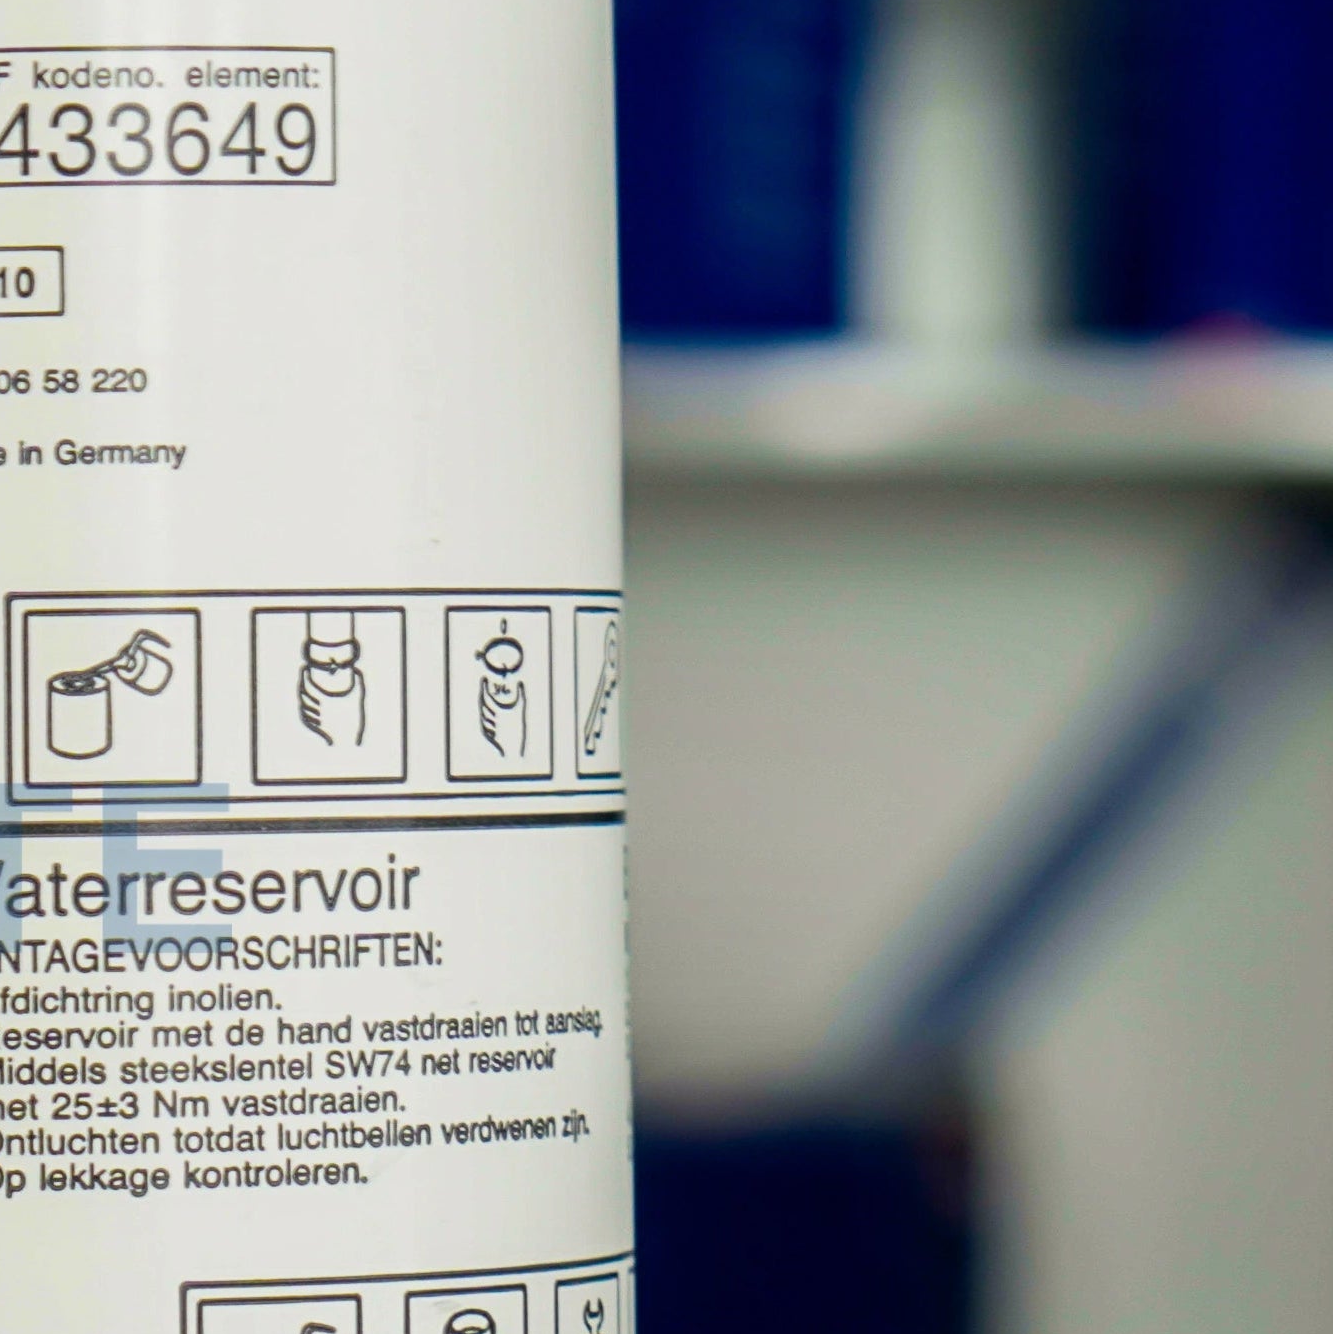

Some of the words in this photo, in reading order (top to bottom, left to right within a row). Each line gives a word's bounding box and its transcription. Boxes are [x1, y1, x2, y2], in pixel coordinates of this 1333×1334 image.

[33, 60, 164, 91] kodeno.
[185, 60, 321, 91] element:
[42, 369, 80, 394] 58
[92, 368, 148, 394] 220
[19, 440, 43, 466] in
[54, 439, 186, 470] Germany
[168, 983, 283, 1013] inolien.
[152, 1020, 214, 1049] met
[226, 1017, 265, 1047] de
[277, 1015, 352, 1046] hand
[363, 1009, 508, 1043] vastdraaien
[514, 1009, 540, 1038] tot
[325, 1050, 411, 1080] SW74
[469, 1043, 557, 1074] reservoir
[52, 1092, 140, 1120] 25±3
[153, 1091, 210, 1119] Nm
[223, 1086, 406, 1117] vastdraaien.
[174, 1125, 265, 1154] totdat
[277, 1117, 432, 1151] luchtbellen
[441, 1114, 557, 1144] verdwenen
[40, 1161, 170, 1198] lekkage
[183, 1159, 369, 1188] kontroleren.
